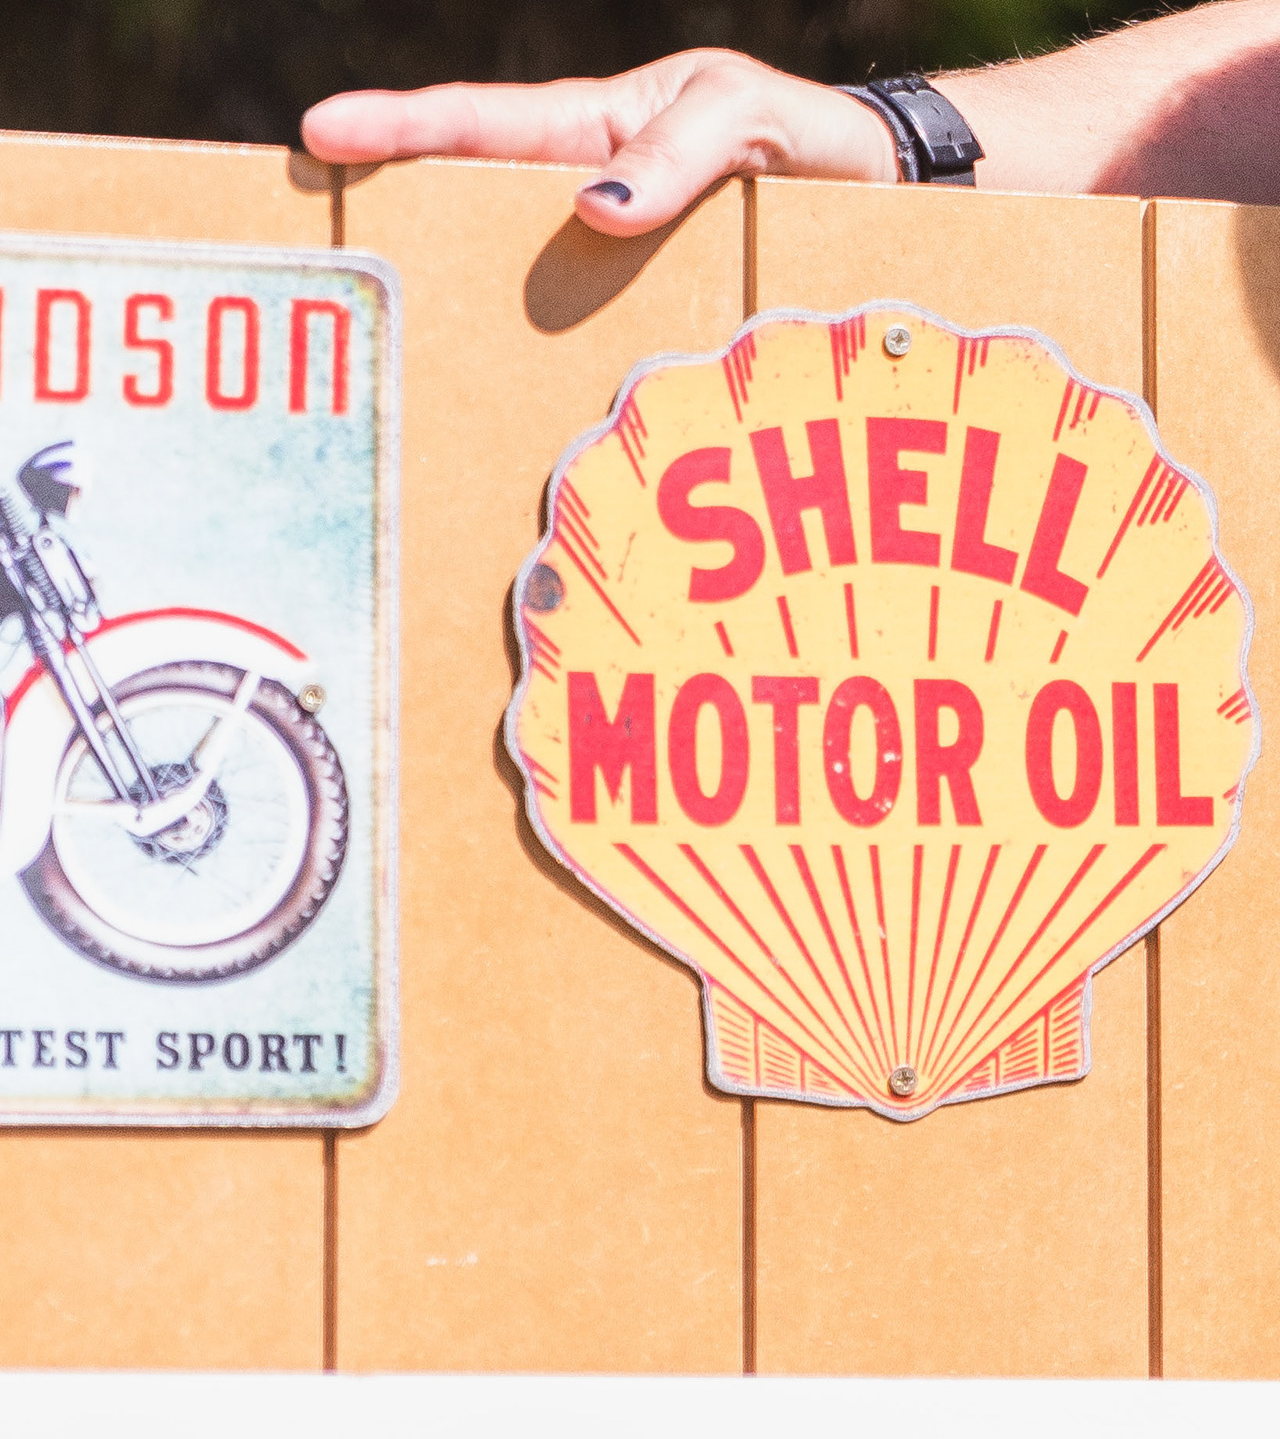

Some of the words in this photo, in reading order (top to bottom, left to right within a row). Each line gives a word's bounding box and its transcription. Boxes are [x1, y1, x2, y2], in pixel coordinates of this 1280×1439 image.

[0, 286, 351, 415] DSON
[656, 417, 1090, 617] SHELL
[567, 671, 985, 828] MOTOR
[1025, 679, 1215, 829] OIL
[0, 1029, 124, 1069] TEST
[156, 1031, 348, 1073] SPORT!
